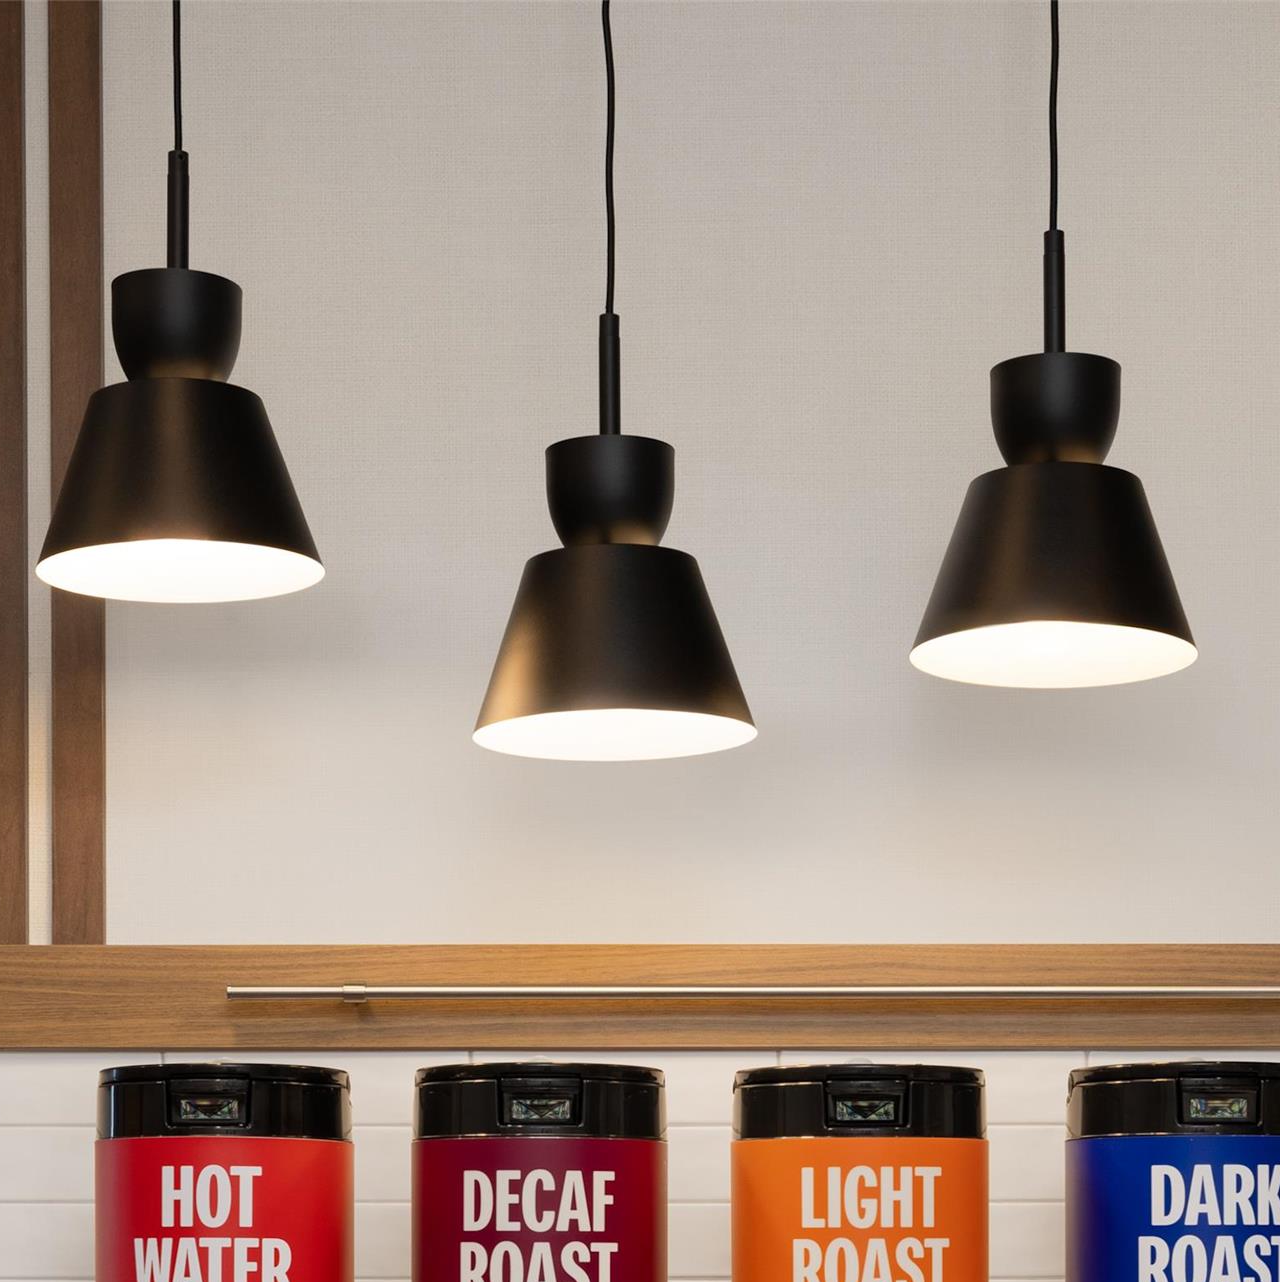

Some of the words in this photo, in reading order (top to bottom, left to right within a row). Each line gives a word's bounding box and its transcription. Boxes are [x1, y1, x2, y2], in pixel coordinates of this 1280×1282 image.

[161, 1164, 262, 1228] HOT
[462, 1169, 615, 1233] DECAF
[801, 1165, 942, 1230] LIGHT
